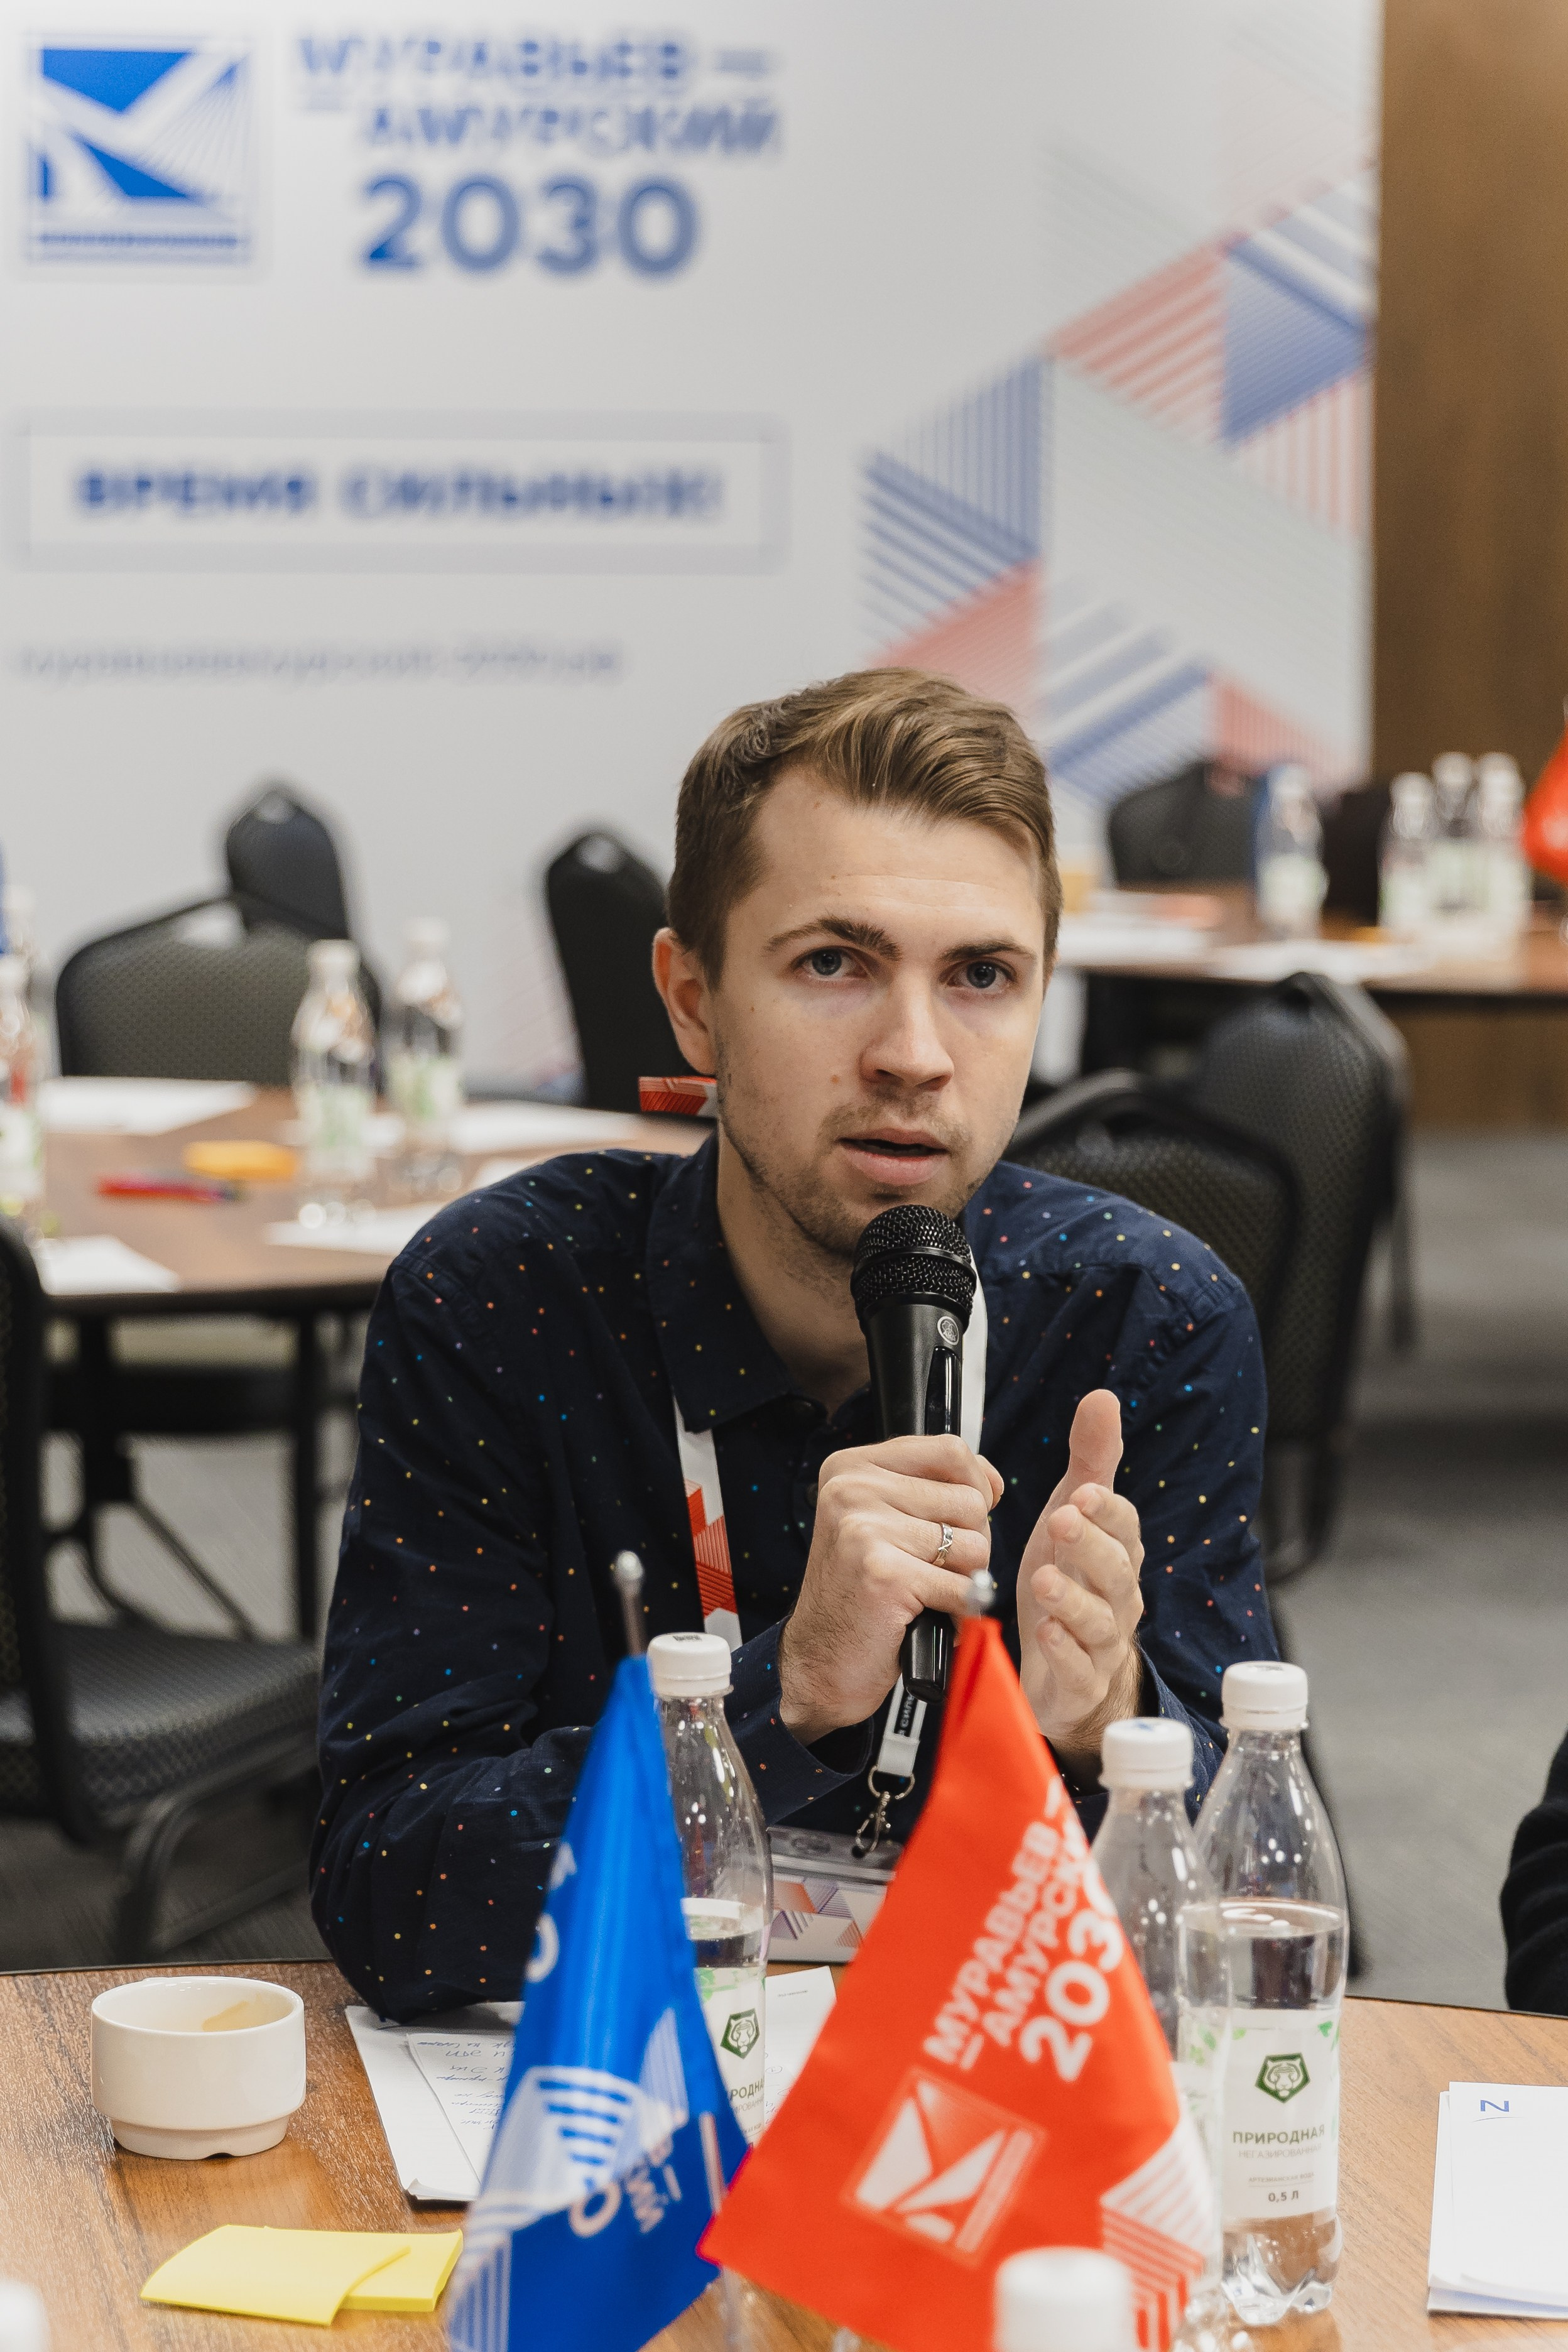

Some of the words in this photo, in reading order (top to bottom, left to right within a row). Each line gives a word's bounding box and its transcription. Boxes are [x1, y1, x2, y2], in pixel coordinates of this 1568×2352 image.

[358, 172, 702, 275] 2030
[1232, 2124, 1325, 2145] ПРИРОДНАЯ
[1238, 2143, 1322, 2159] НЕГАЗИРОВАННАЯ
[1268, 2191, 1287, 2202] 0,5
